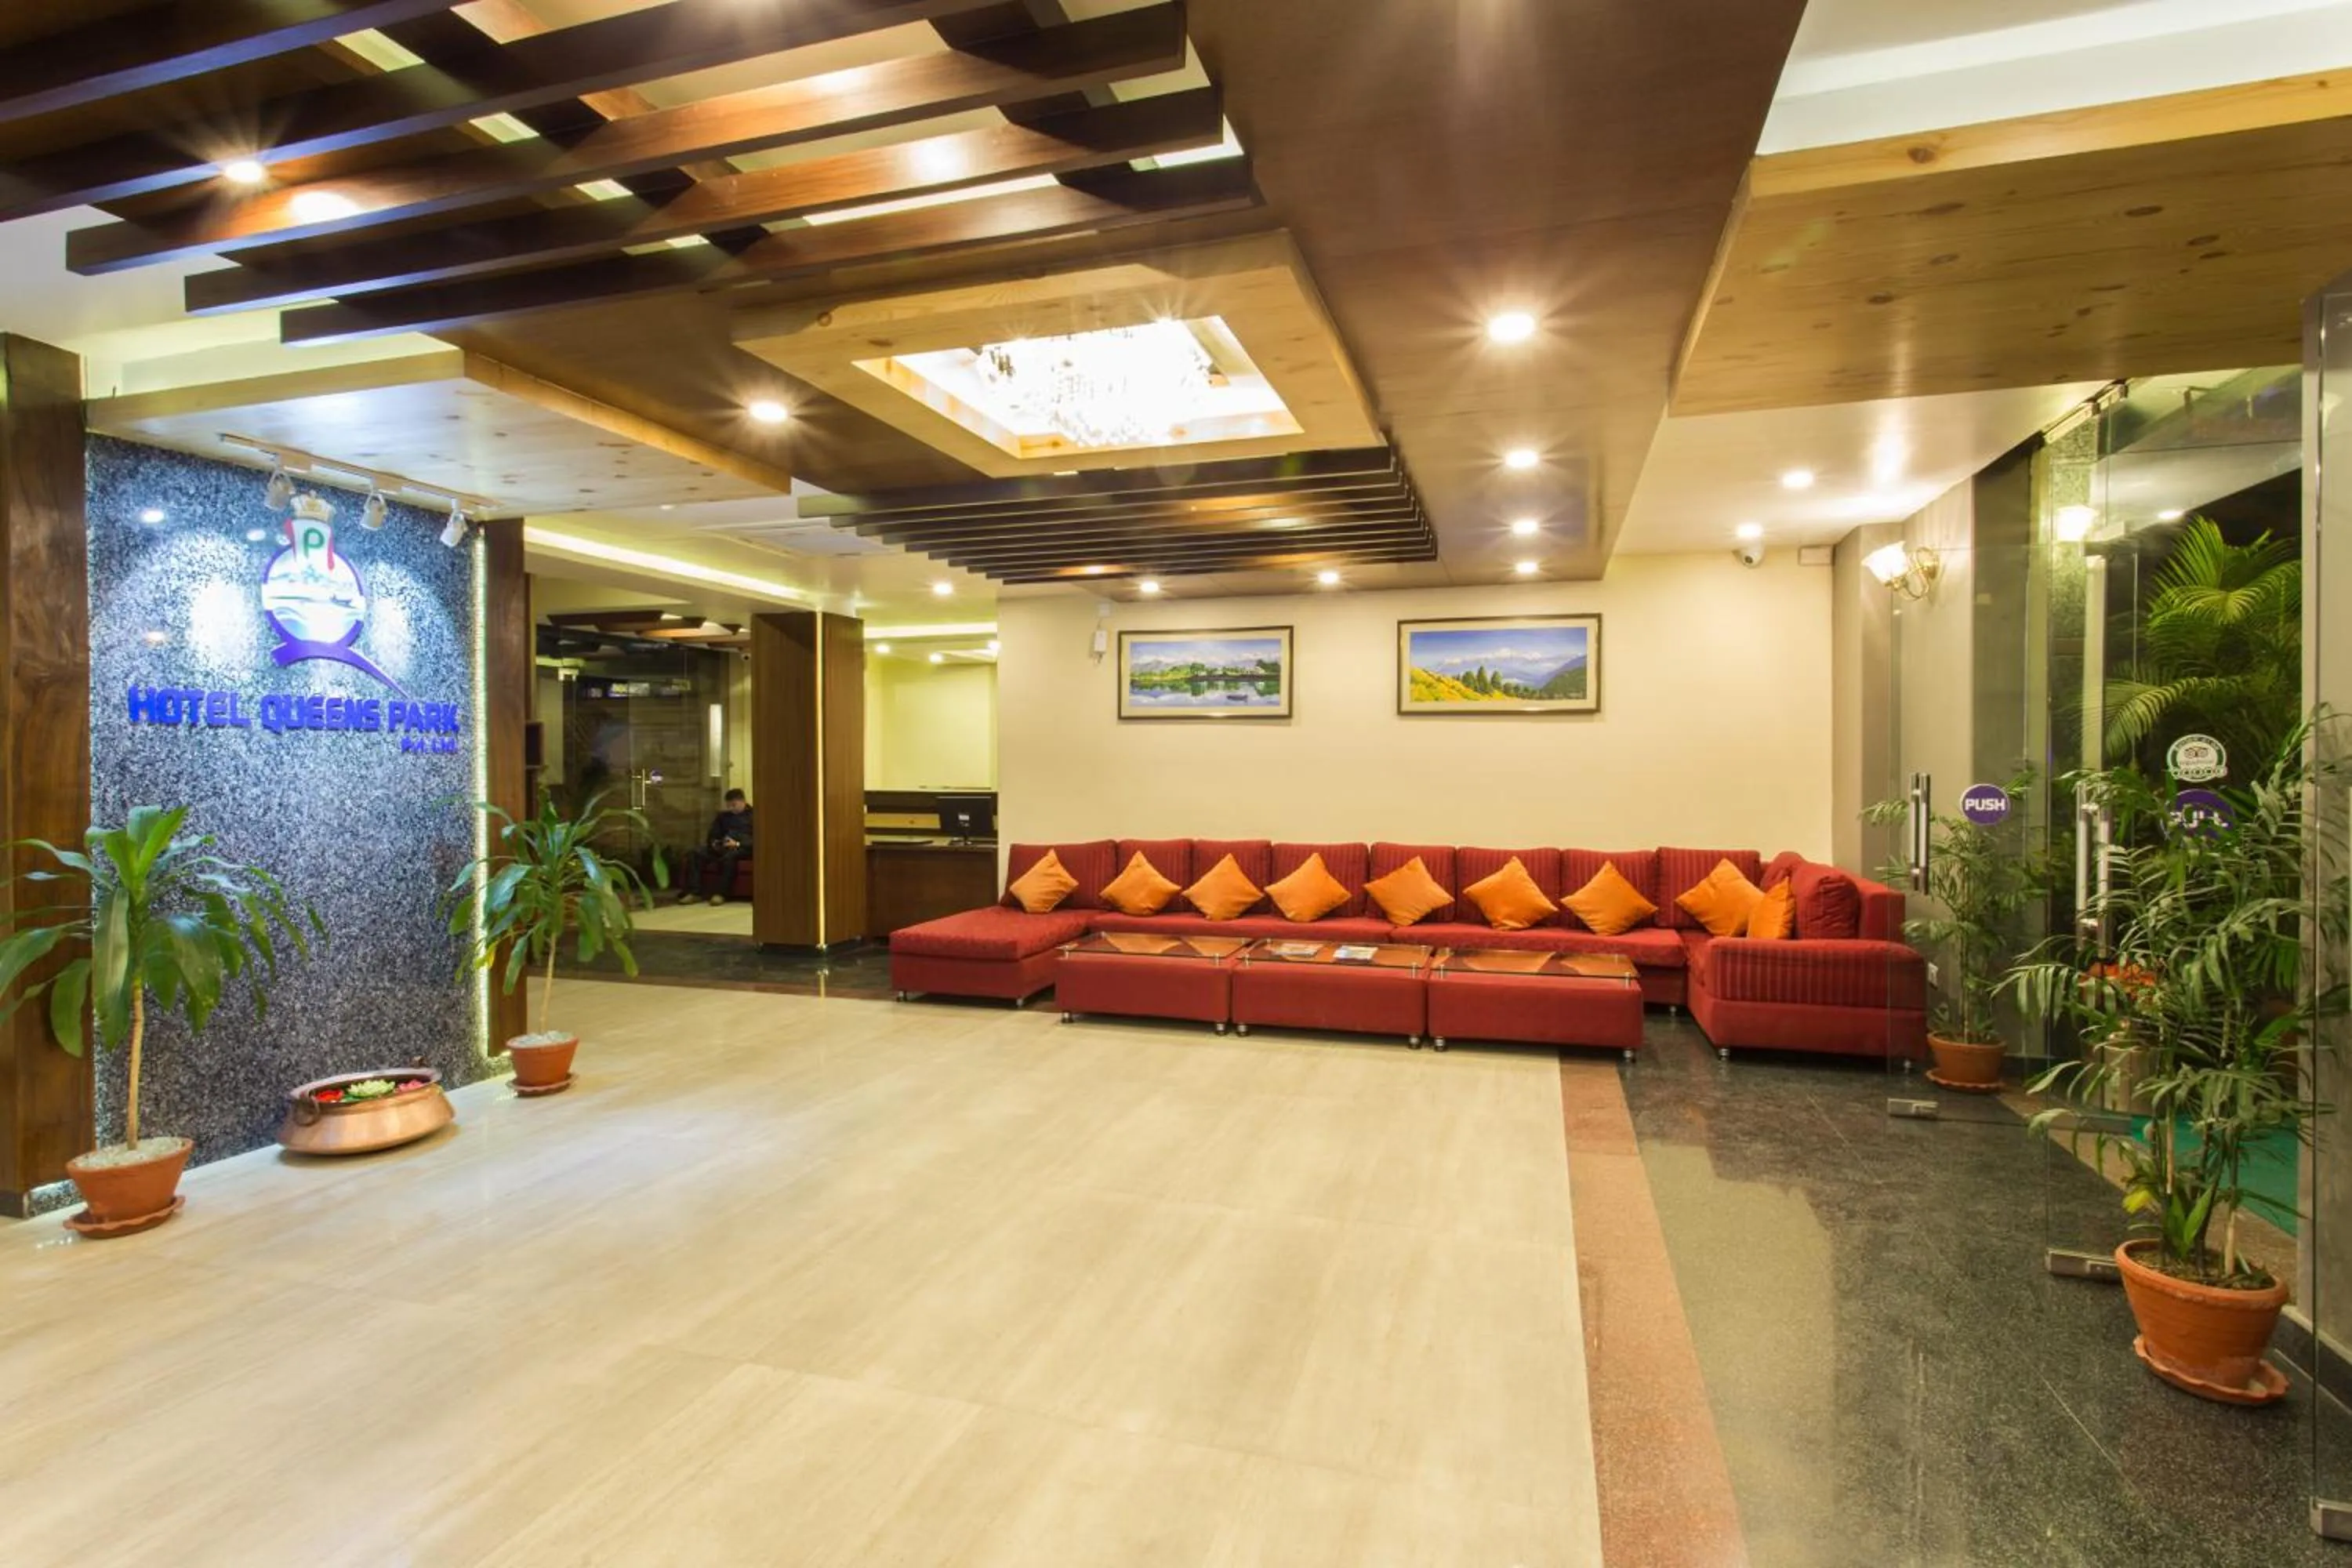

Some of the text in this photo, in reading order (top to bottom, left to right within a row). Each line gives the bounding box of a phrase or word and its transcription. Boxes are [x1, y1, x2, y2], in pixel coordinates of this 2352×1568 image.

[128, 684, 459, 735] HOTEL QUEENS PARK
[1965, 798, 2005, 811] PUSH
